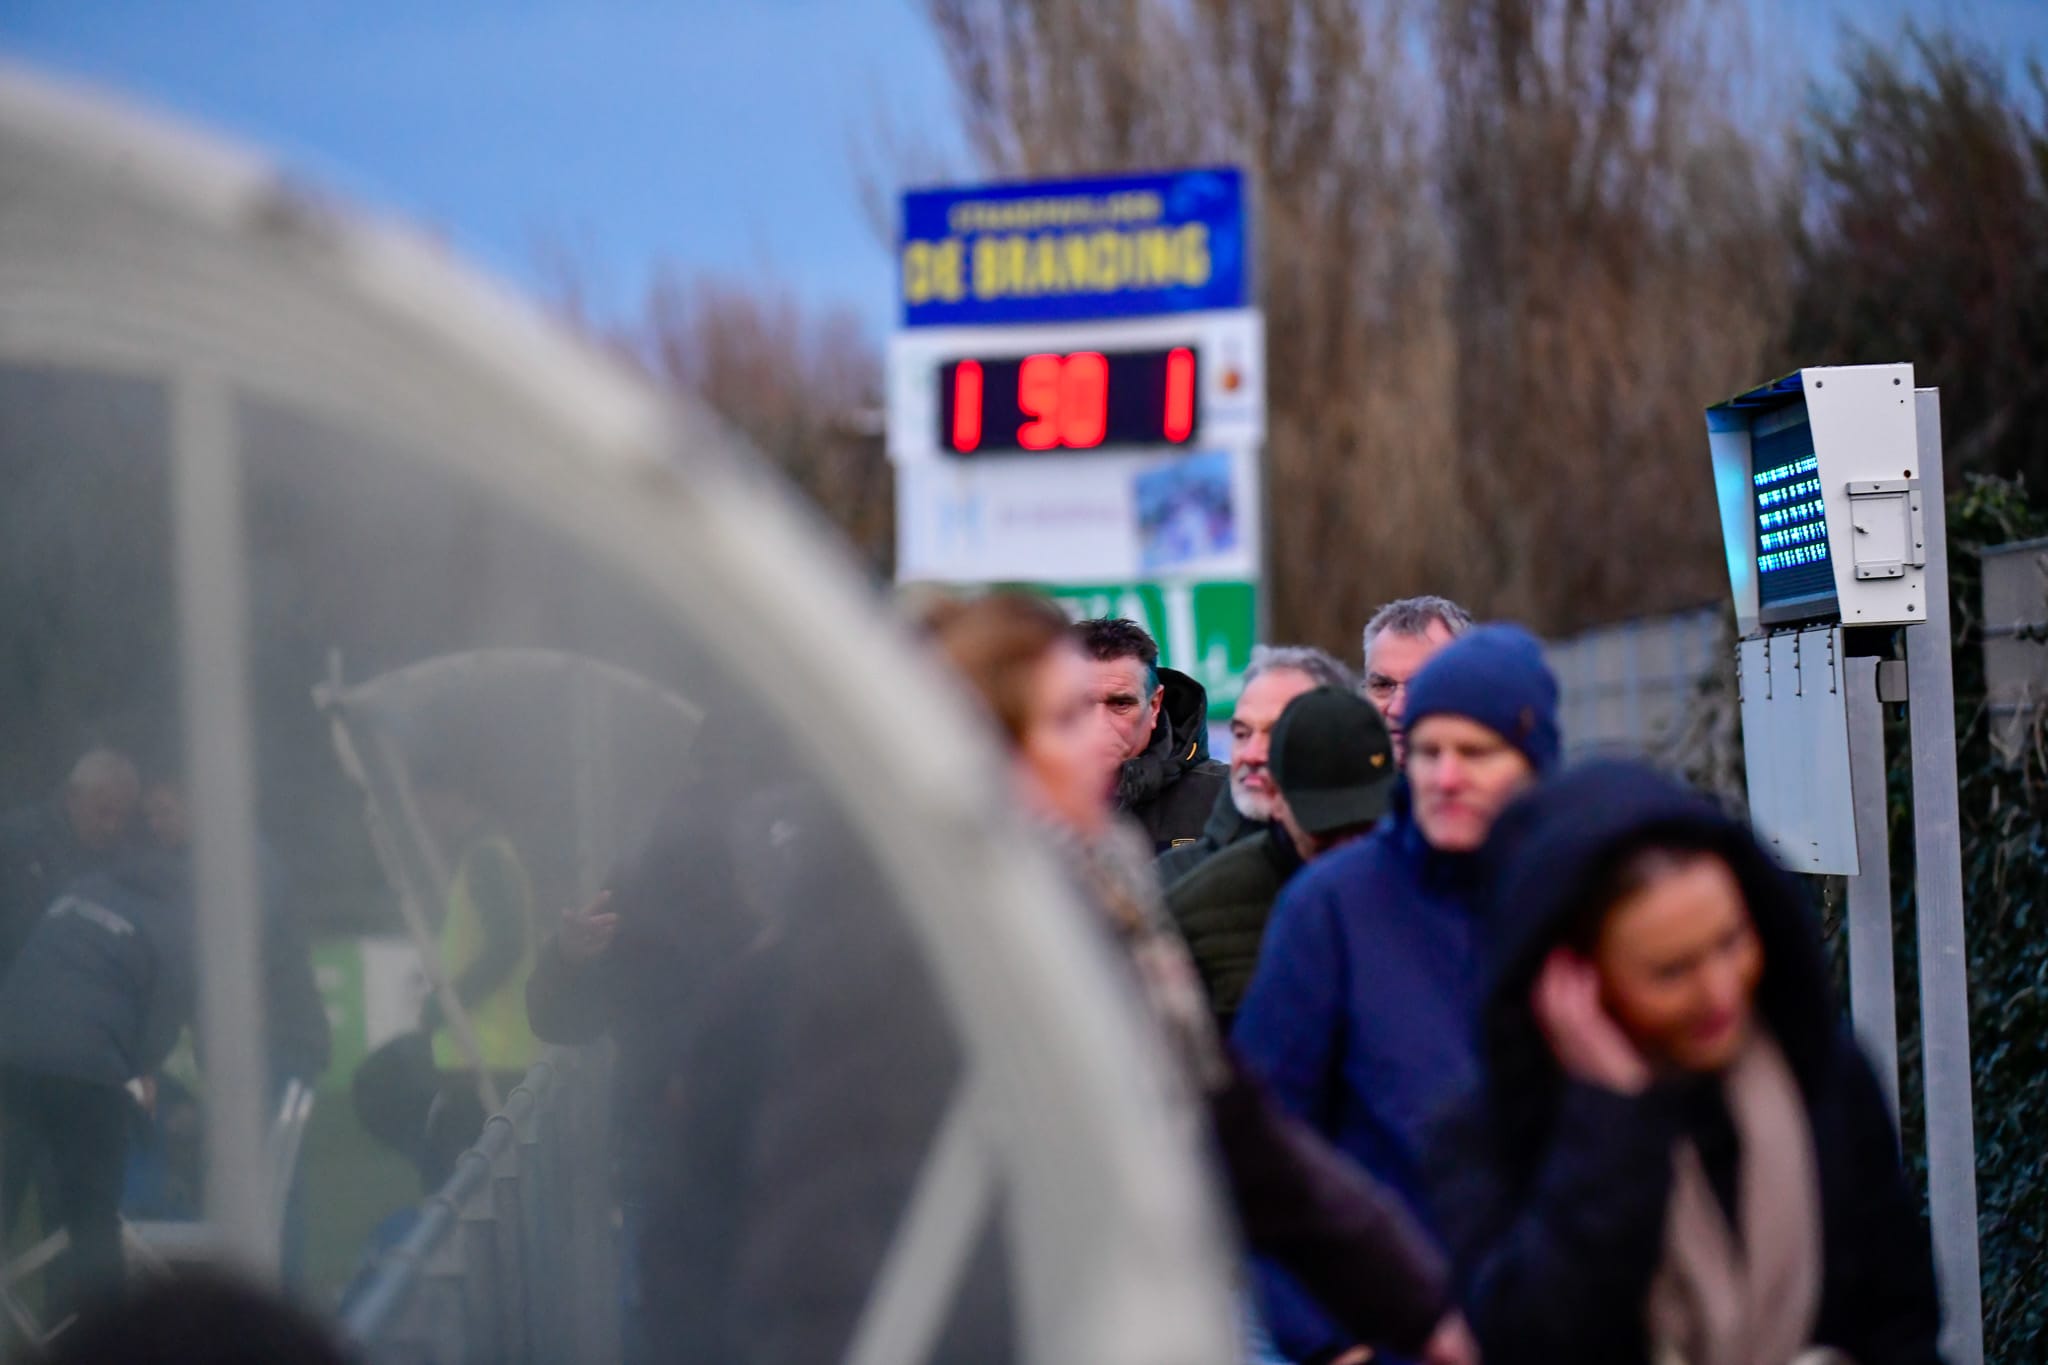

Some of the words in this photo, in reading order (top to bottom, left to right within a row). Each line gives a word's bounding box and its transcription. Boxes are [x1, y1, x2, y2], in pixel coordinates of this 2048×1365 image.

[904, 239, 964, 303] DE
[972, 220, 1211, 302] BRANDING
[953, 359, 983, 453] 1
[1164, 347, 1195, 444] 1
